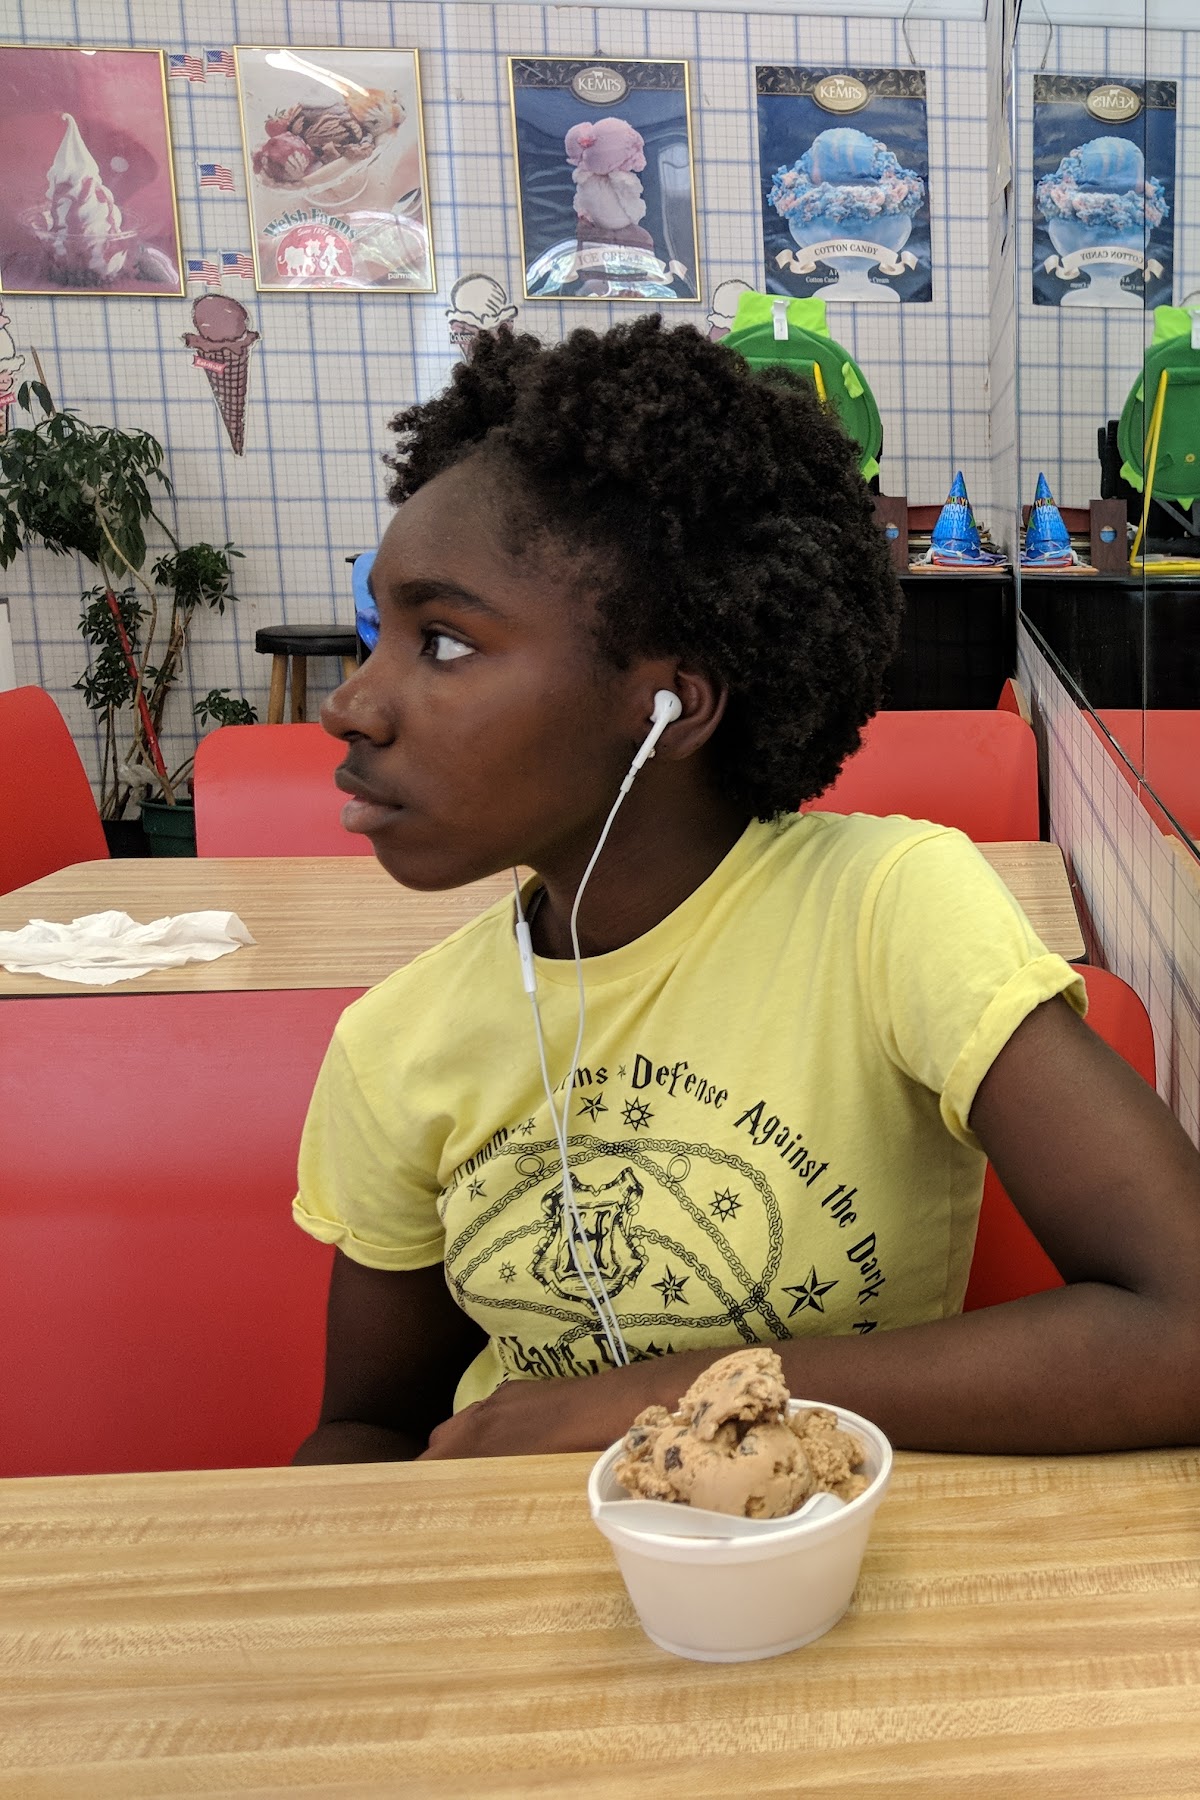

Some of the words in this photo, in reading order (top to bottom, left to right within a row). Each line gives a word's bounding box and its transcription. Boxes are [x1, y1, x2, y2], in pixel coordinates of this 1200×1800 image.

[578, 76, 622, 92] KEMPS
[820, 85, 862, 99] KEMPS
[263, 207, 308, 238] Welsh
[814, 243, 848, 256] COTTON
[850, 243, 879, 255] CANDY
[577, 252, 600, 266] ICE
[631, 1053, 729, 1110] Defense
[733, 1100, 831, 1188] Against
[821, 1184, 859, 1228] the
[846, 1231, 886, 1306] Dark
